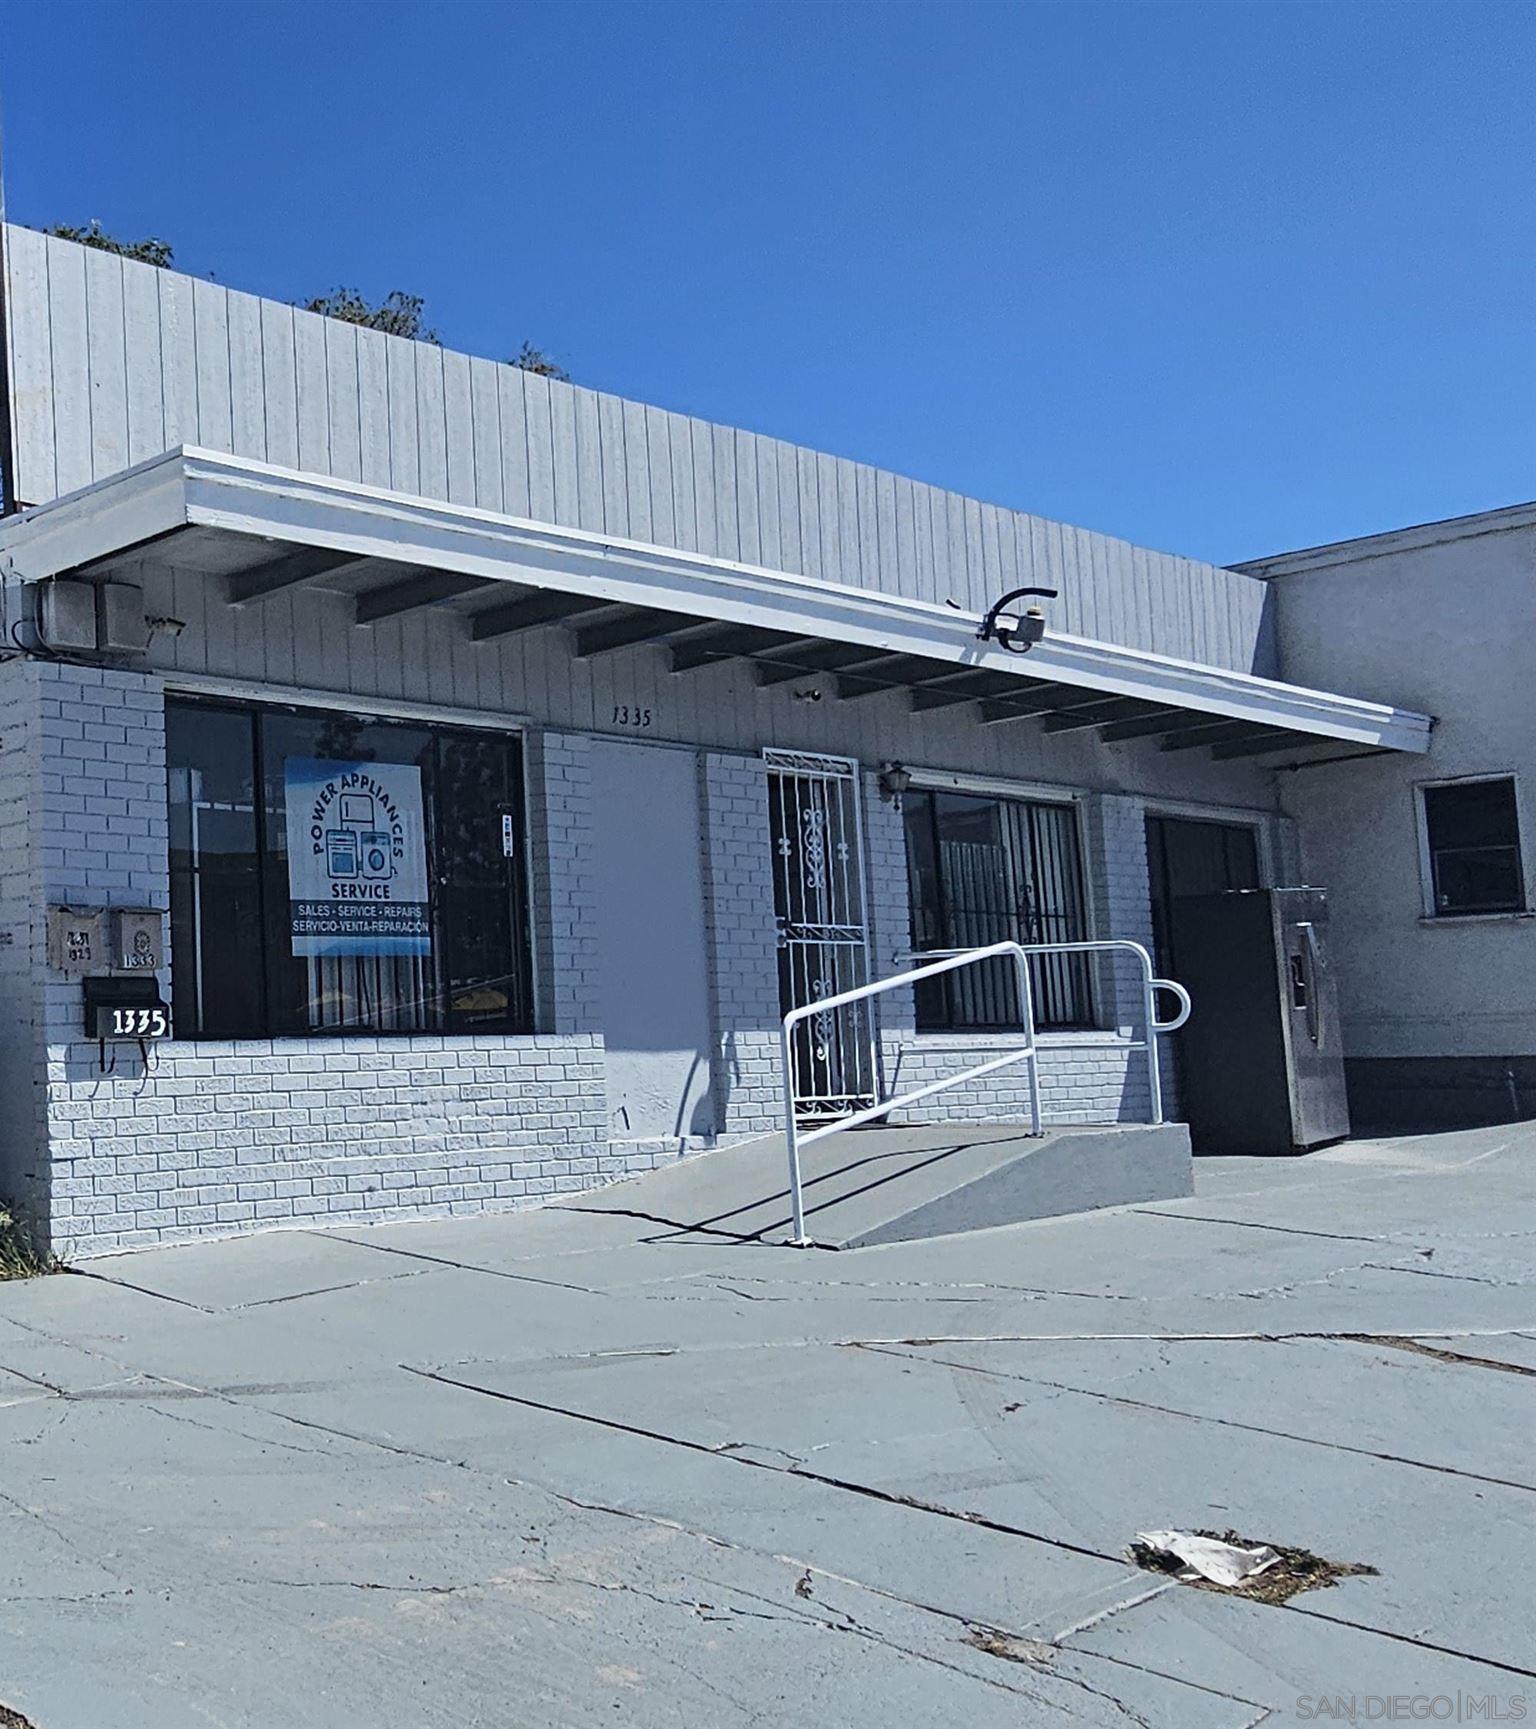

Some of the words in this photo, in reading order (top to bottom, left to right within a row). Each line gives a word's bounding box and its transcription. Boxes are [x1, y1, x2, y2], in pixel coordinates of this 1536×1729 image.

[612, 706, 651, 727] 1335
[310, 782, 338, 856] POWER
[341, 773, 404, 859] APPLIANCES
[331, 882, 391, 899] SERVICE
[298, 904, 330, 917] SALES
[337, 905, 377, 918] SERVICE
[384, 906, 422, 918] REPAIRS
[125, 953, 155, 968] 1333
[113, 1009, 166, 1037] 1335
